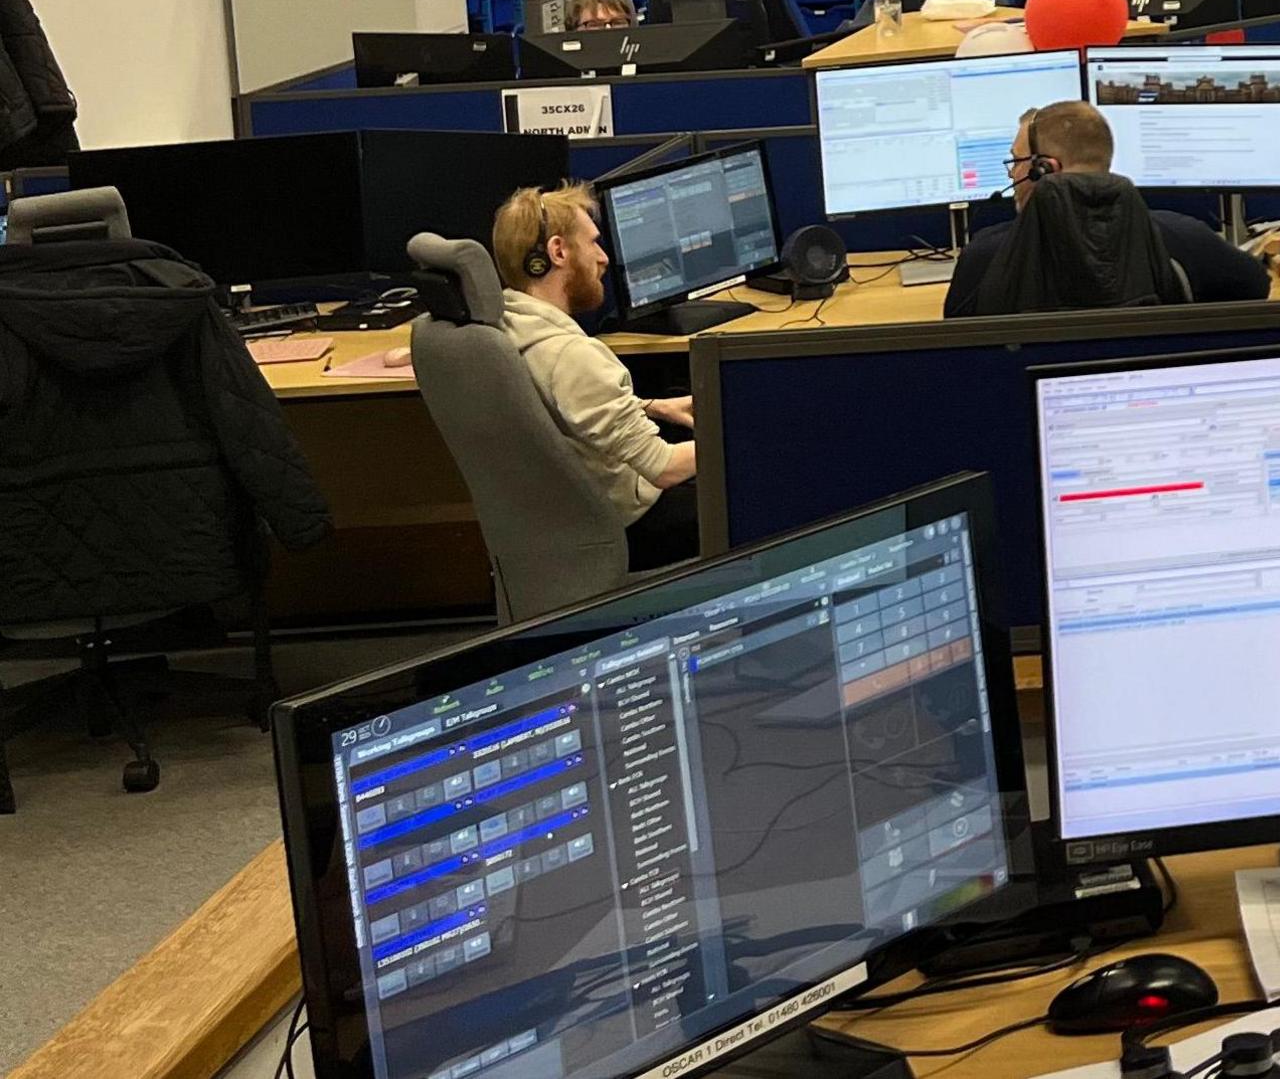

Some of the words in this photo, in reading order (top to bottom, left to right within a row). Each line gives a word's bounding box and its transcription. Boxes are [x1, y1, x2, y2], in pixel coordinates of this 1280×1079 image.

[620, 36, 640, 62] hp
[541, 104, 585, 115] 35CX26
[567, 125, 608, 135] ADMN
[341, 730, 357, 747] 29
[662, 1049, 703, 1078] OSCAR
[706, 1045, 712, 1056] 1
[715, 1028, 745, 1051] Direct
[768, 1002, 800, 1025] 01480
